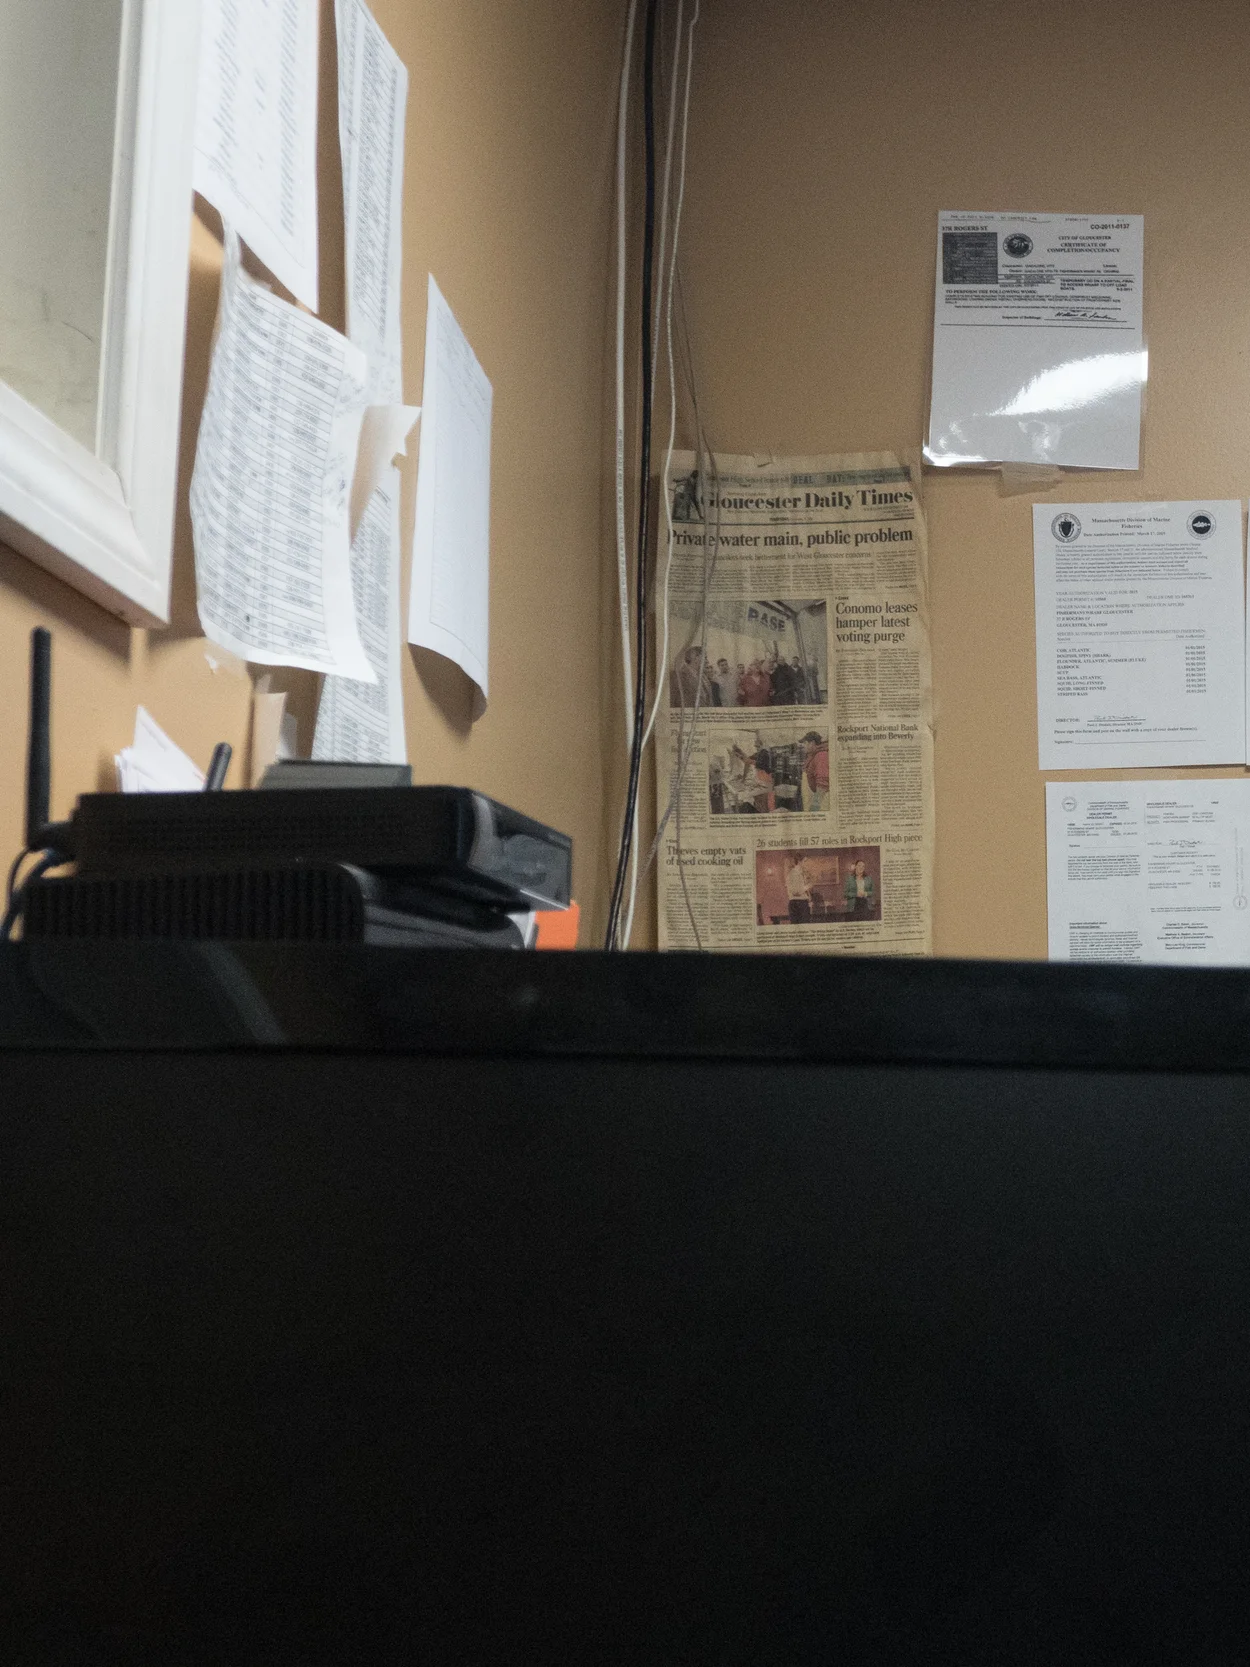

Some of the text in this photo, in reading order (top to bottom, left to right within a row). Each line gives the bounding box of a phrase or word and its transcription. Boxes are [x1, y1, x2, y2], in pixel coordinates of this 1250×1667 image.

[805, 491, 854, 510] Daily
[856, 488, 914, 506] Times
[719, 533, 761, 547] water
[763, 531, 803, 548] main,
[807, 529, 851, 548] public
[854, 527, 914, 547] problem
[836, 600, 918, 615] Conomo leases
[836, 615, 911, 631] hamper latest
[836, 630, 906, 645] voting purge
[837, 723, 919, 734] Rockport National Bank
[837, 732, 914, 742] expanding into Beverly
[756, 838, 766, 848] 26
[768, 837, 797, 848] students
[810, 836, 820, 846] 57
[821, 836, 839, 846] roles
[840, 837, 848, 845] in
[850, 834, 882, 845] Rockport
[884, 833, 902, 844] High
[904, 833, 923, 844] piece
[700, 846, 727, 857] empty
[729, 846, 747, 855] vats
[666, 856, 675, 866] of
[697, 856, 731, 867] cooking
[733, 856, 744, 866] oil
